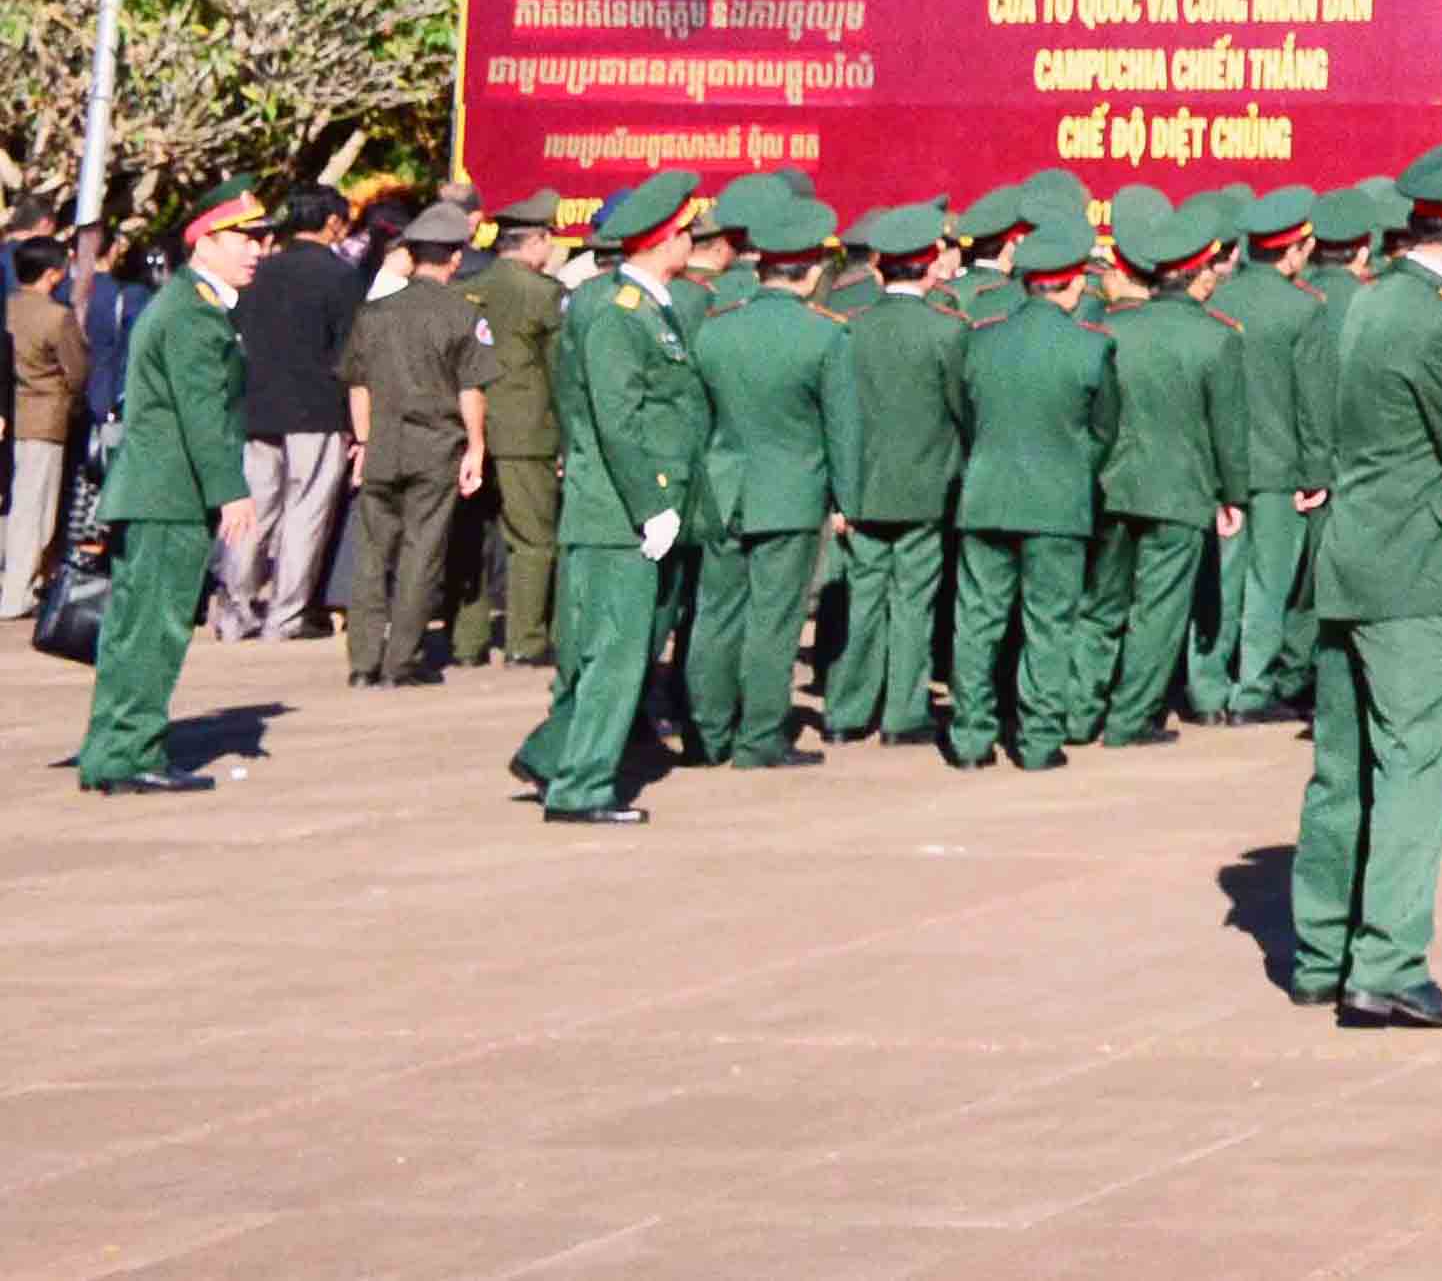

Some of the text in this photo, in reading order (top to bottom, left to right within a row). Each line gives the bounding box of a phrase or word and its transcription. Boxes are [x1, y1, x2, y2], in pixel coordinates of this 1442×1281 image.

[1034, 32, 1330, 93] CAMPUCHIA CHIẾN THẮNG
[1058, 102, 1293, 168] CHẾ ĐỘ DIỆT CHỦNG
